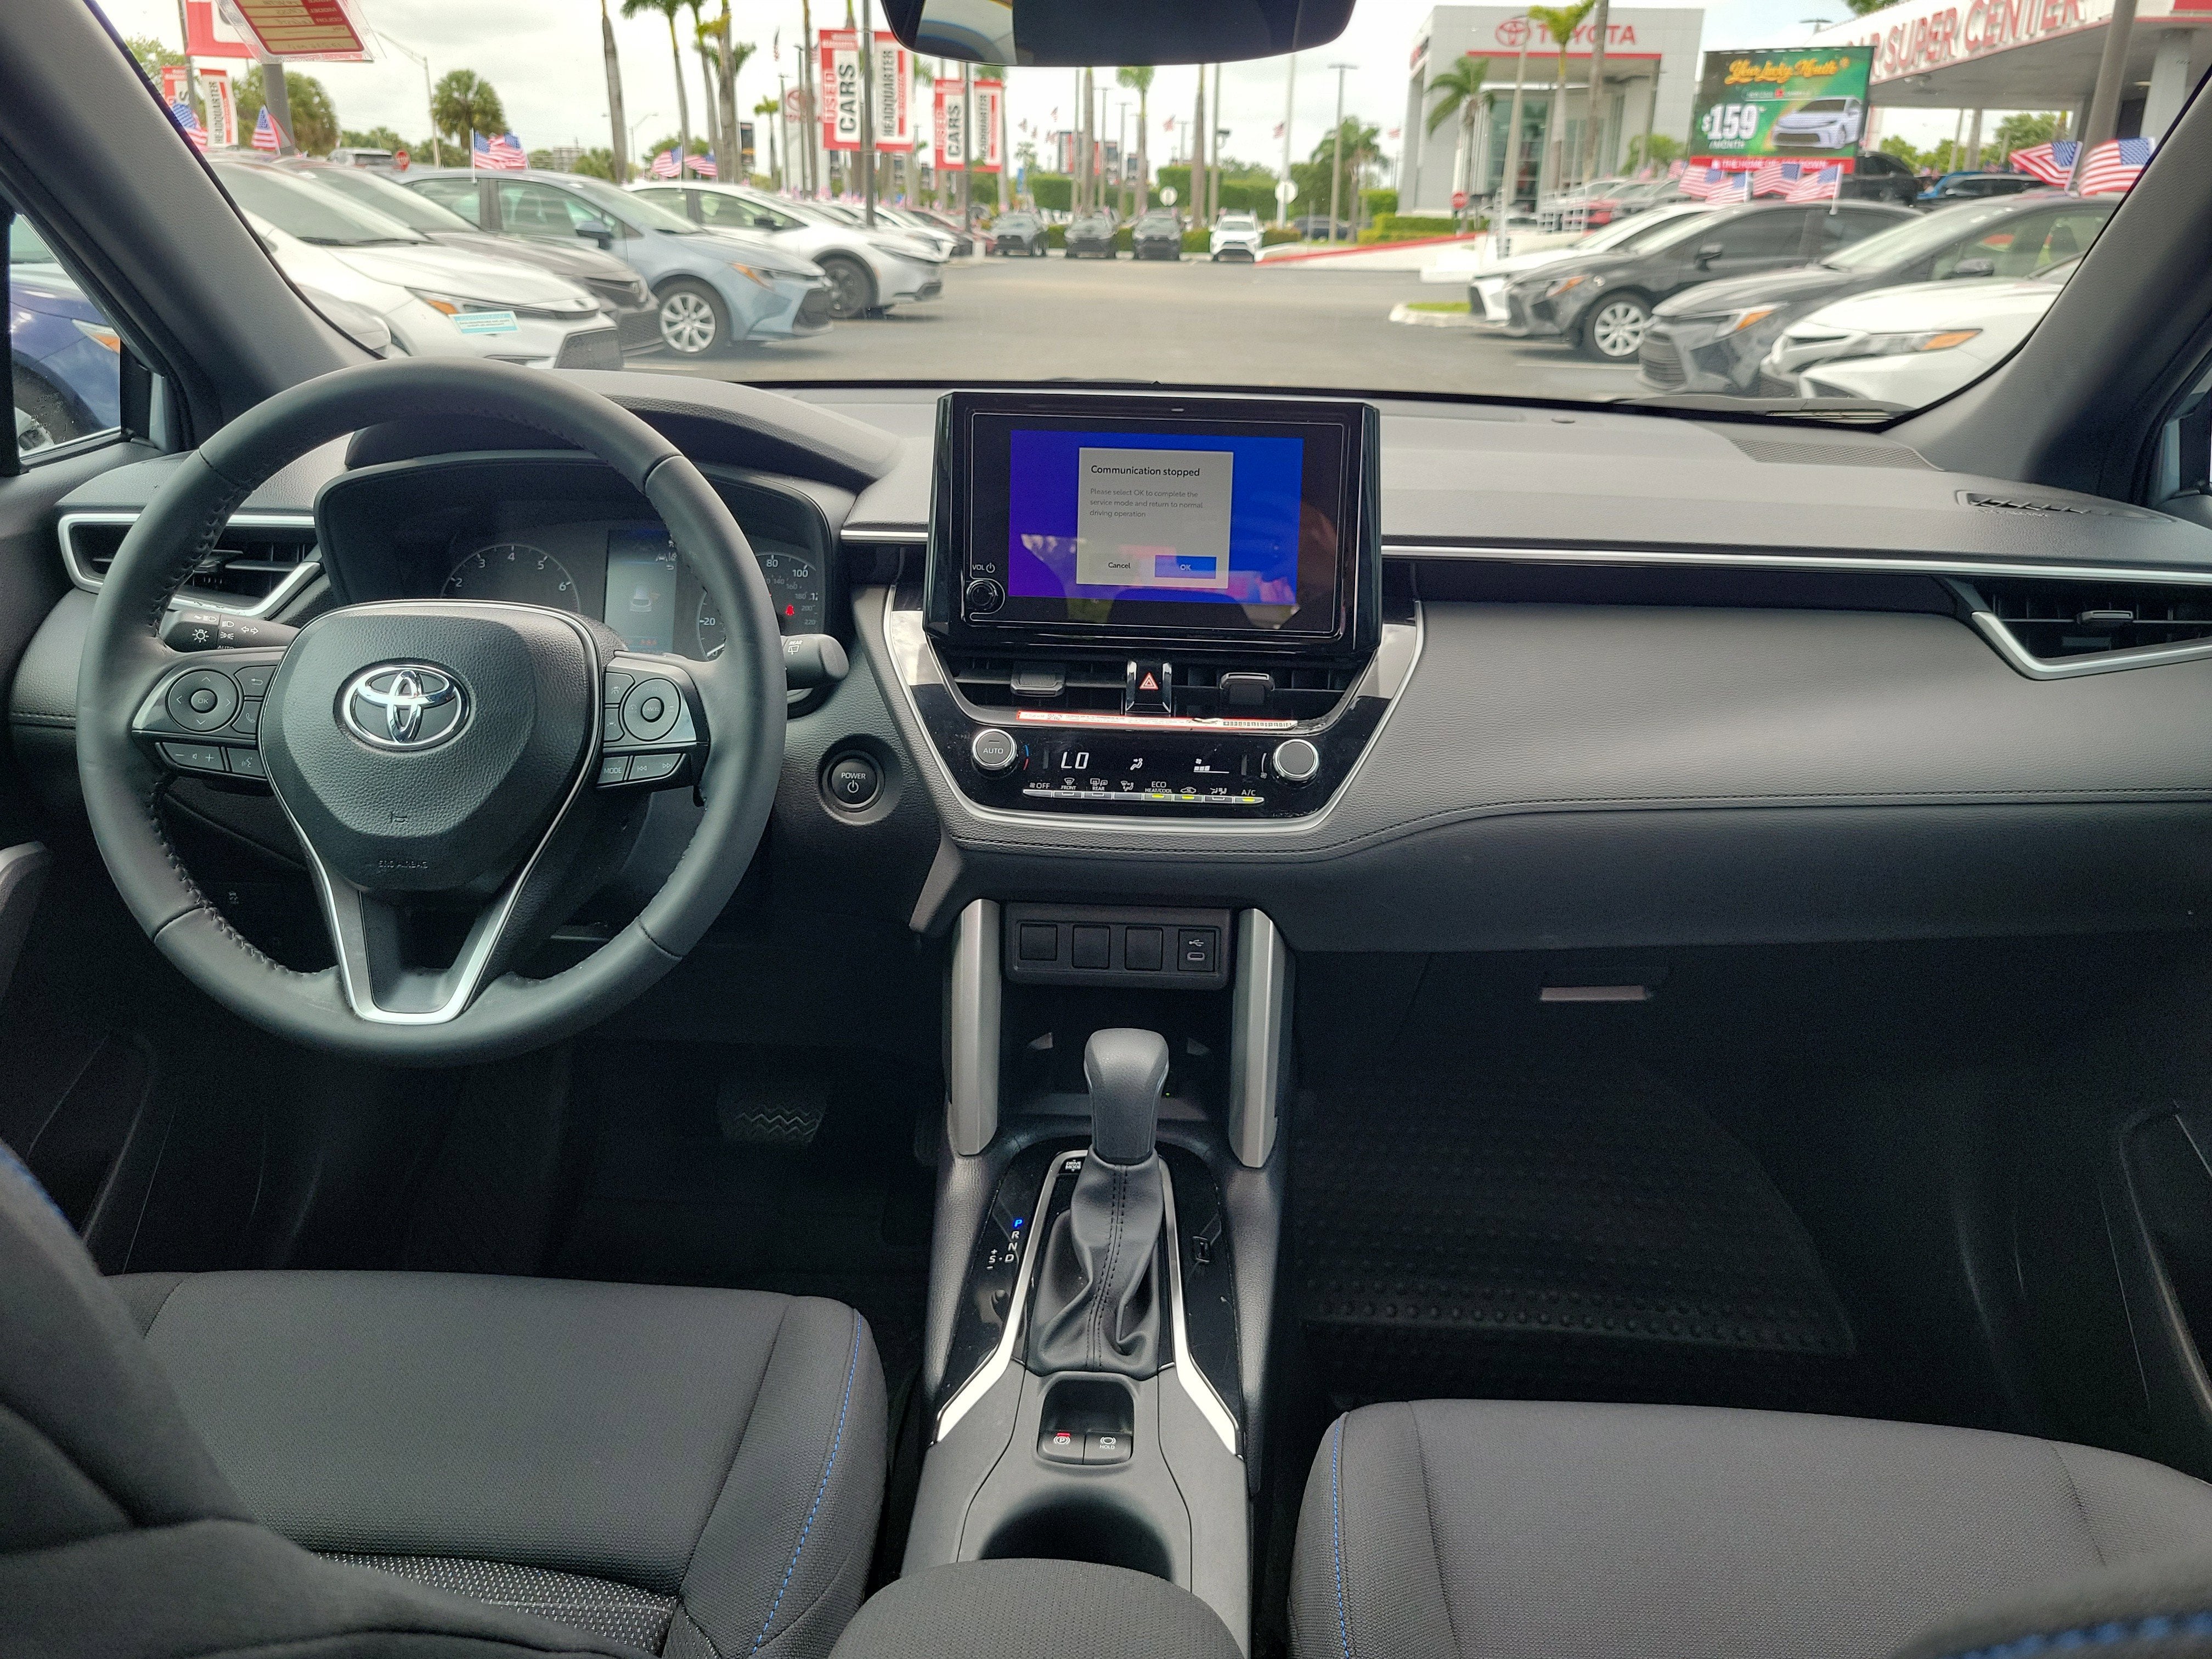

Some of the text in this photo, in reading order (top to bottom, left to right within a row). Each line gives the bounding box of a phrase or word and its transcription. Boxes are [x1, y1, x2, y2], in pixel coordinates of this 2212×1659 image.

[1538, 24, 1635, 44] TYOTA
[1884, 7, 1958, 72] SUPER
[825, 72, 837, 122] USED
[839, 64, 856, 133] CARS
[948, 104, 960, 157] CARS
[1091, 465, 1200, 478] Communication stopped
[1090, 510, 1113, 518] driving
[507, 552, 516, 562] 4
[477, 559, 486, 568] 3
[537, 561, 544, 570] 5
[766, 559, 778, 568] 80
[792, 569, 809, 578] 100
[455, 578, 462, 588] 2
[558, 582, 567, 591] 6
[703, 618, 715, 626] 20
[1060, 752, 1089, 769] LO
[1011, 1231, 1020, 1239] R
[1008, 1242, 1018, 1251] N
[989, 1254, 1014, 1264] S D
